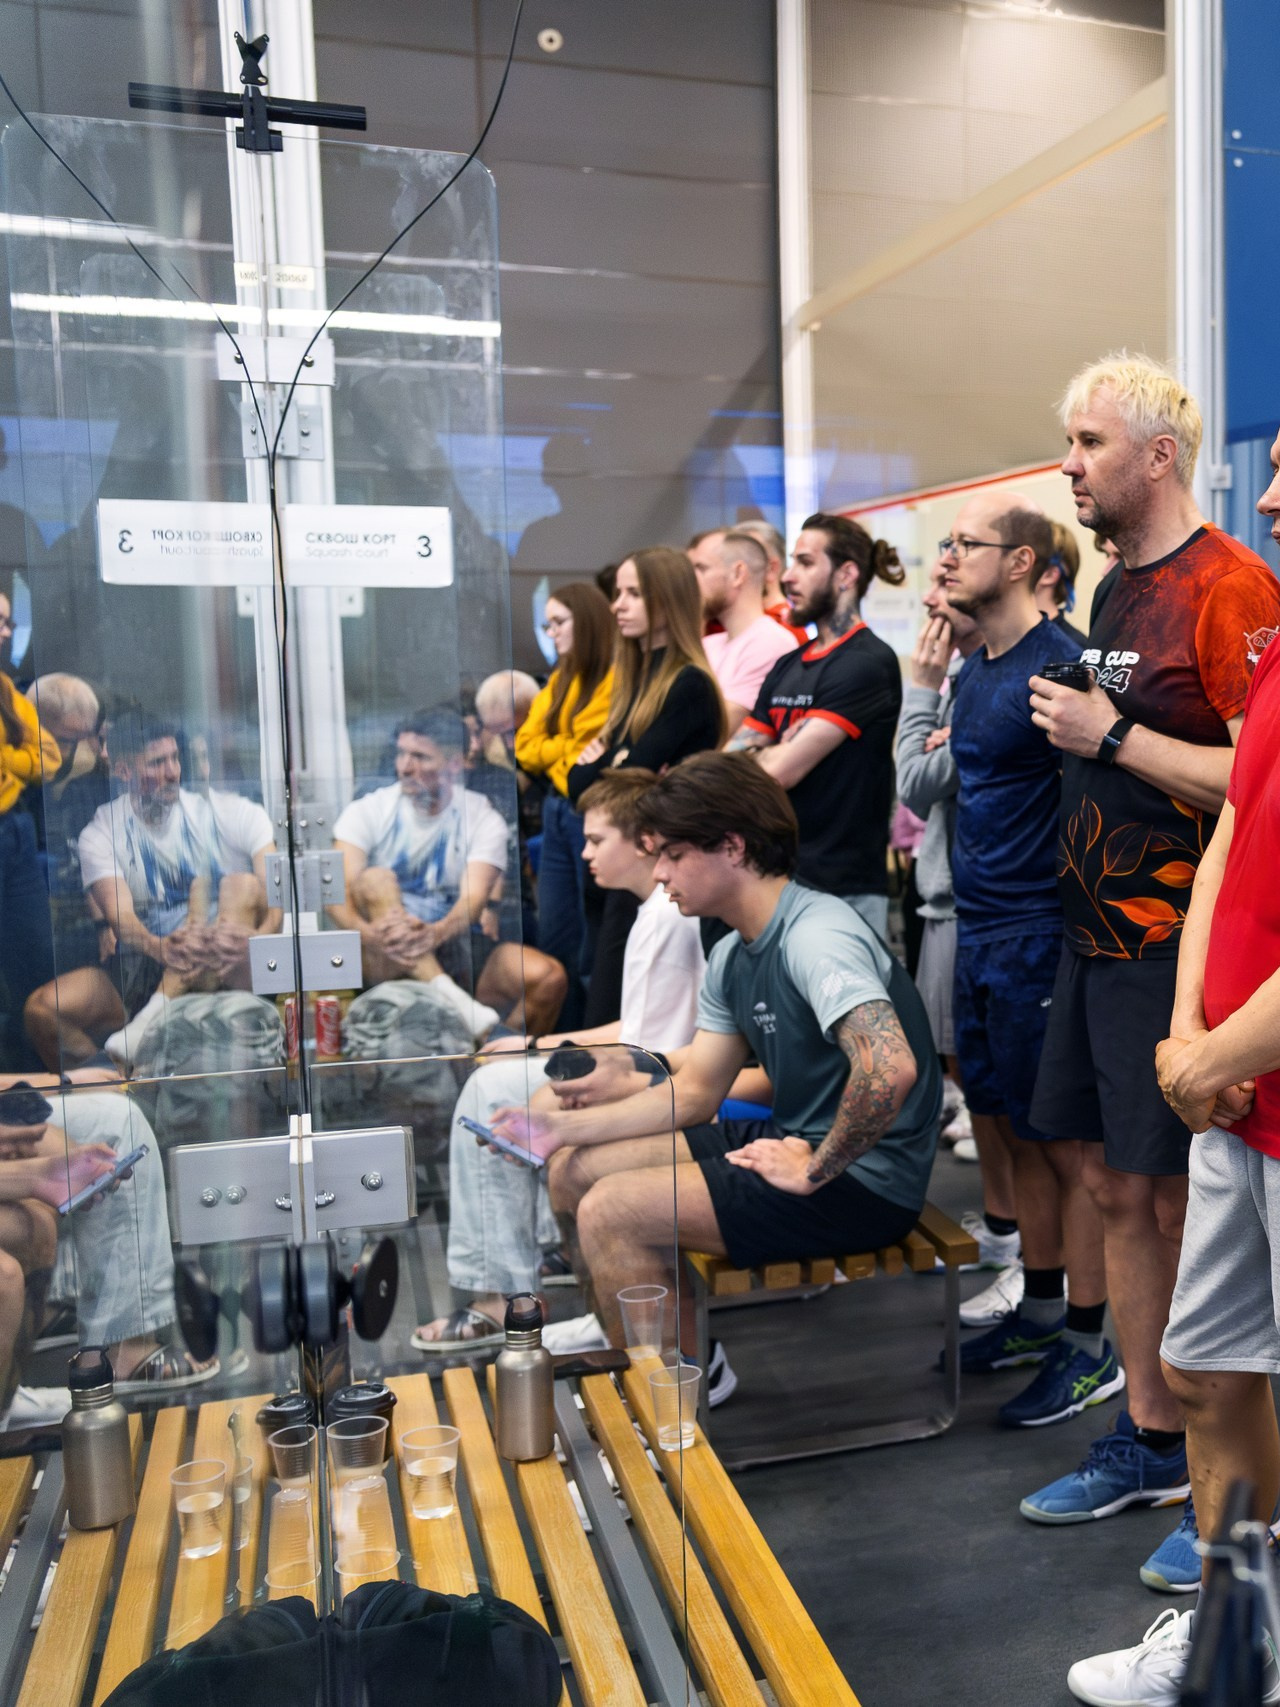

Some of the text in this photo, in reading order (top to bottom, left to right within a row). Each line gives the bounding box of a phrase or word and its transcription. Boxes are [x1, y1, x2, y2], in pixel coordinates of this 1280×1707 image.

[305, 532, 397, 545] СКВОШ КОРТ
[417, 535, 432, 558] 3
[305, 546, 352, 560] Squash
[1079, 648, 1140, 667] PB CUP
